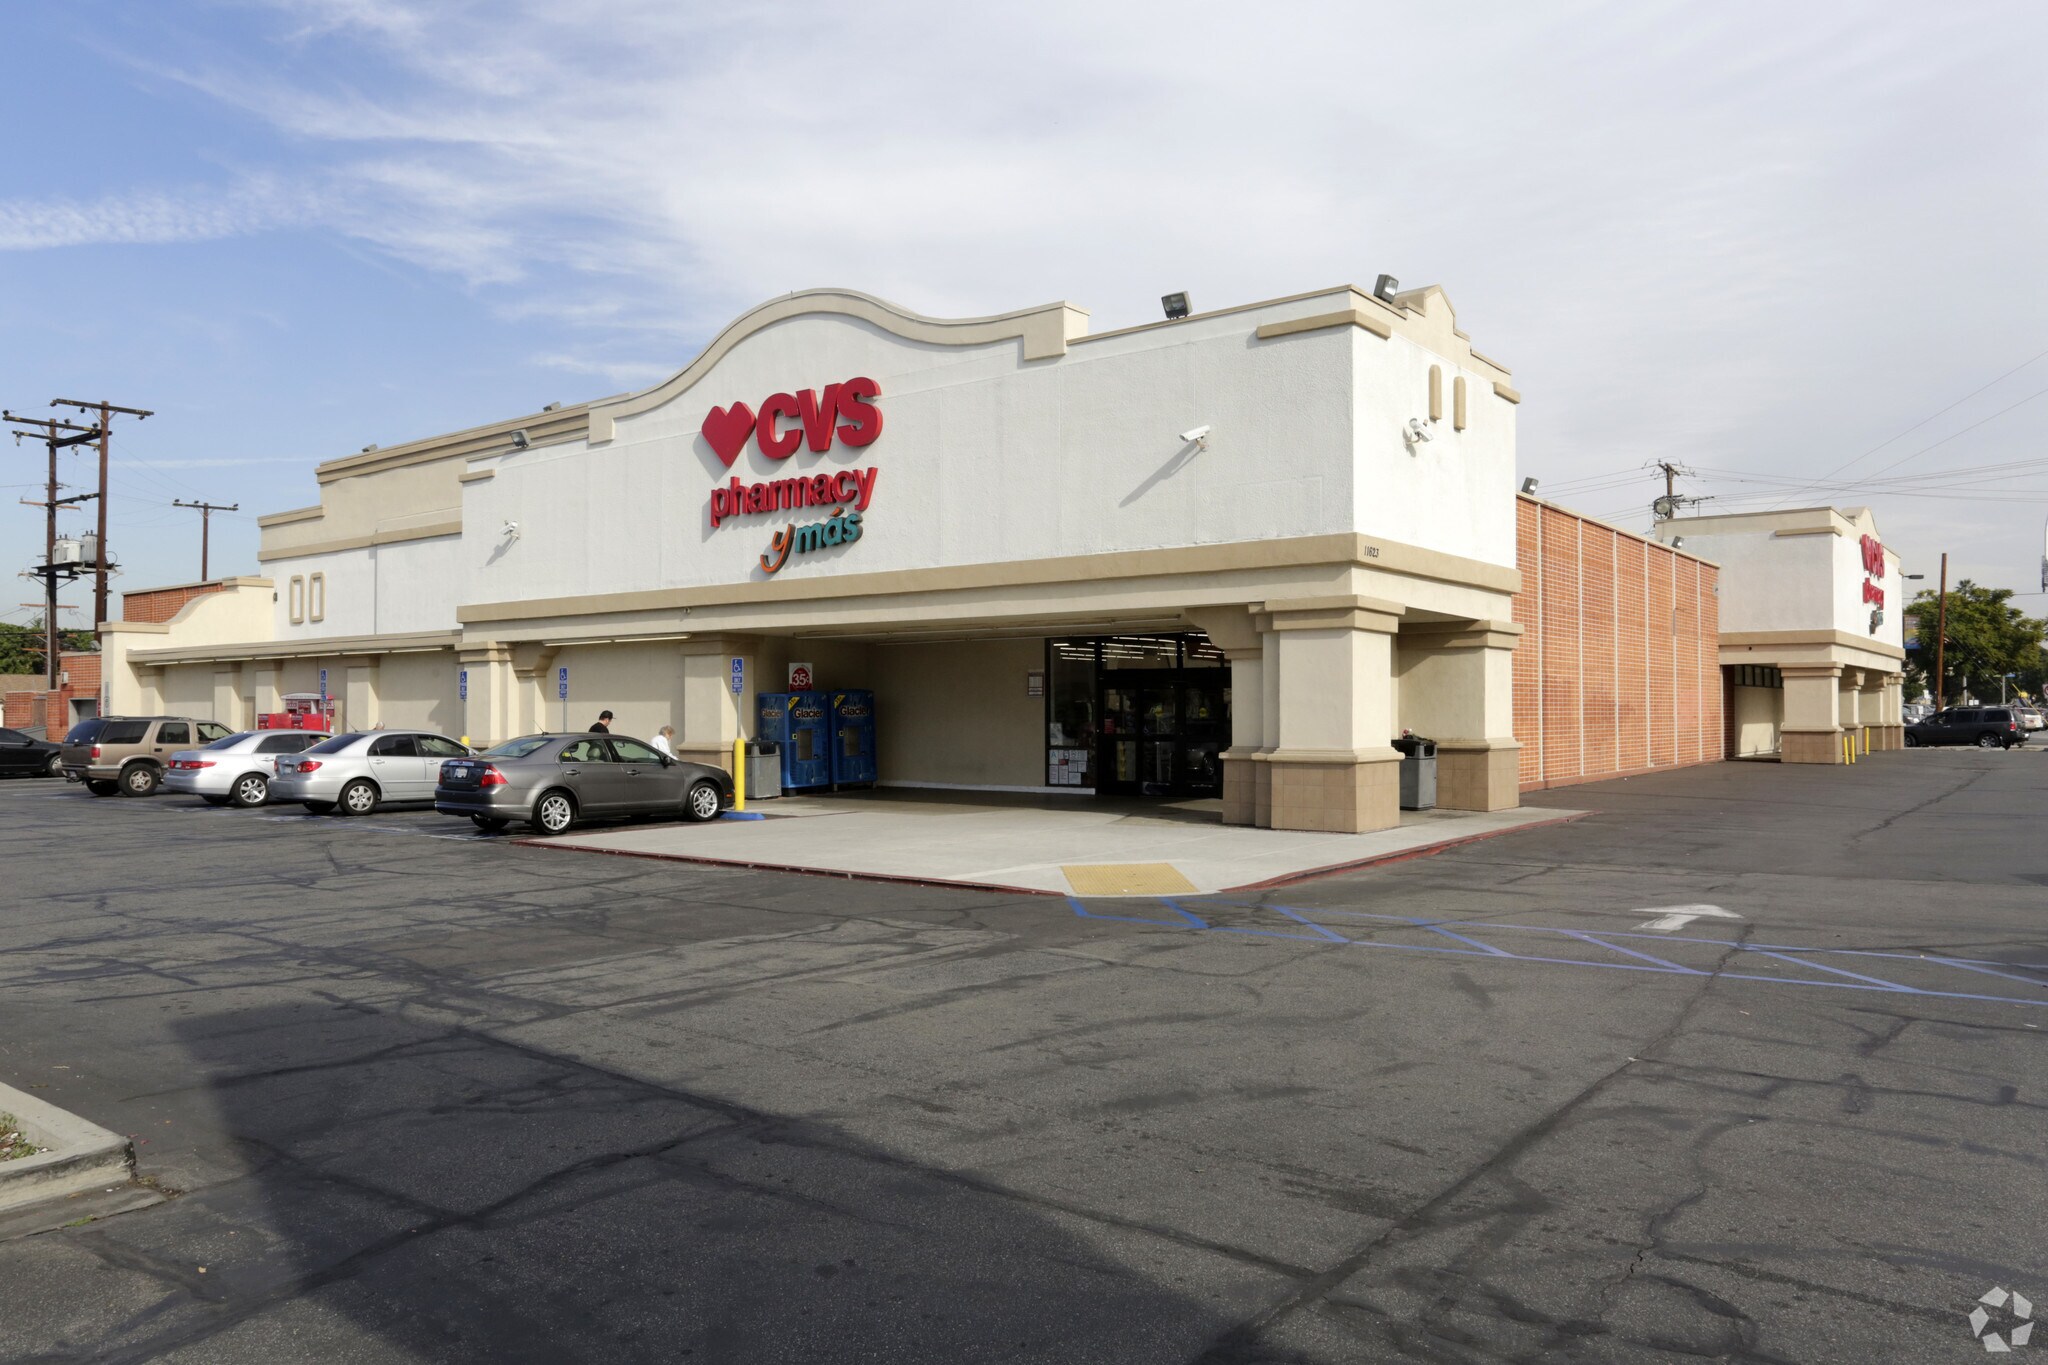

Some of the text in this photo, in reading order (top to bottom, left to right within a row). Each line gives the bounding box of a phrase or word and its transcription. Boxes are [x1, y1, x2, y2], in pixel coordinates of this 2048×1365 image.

[756, 376, 883, 460] CVS
[710, 467, 878, 528] pharmacy
[759, 506, 864, 573] y más
[1364, 545, 1379, 558] 11623
[794, 708, 824, 719] Glacier
[840, 705, 869, 717] Glacier
